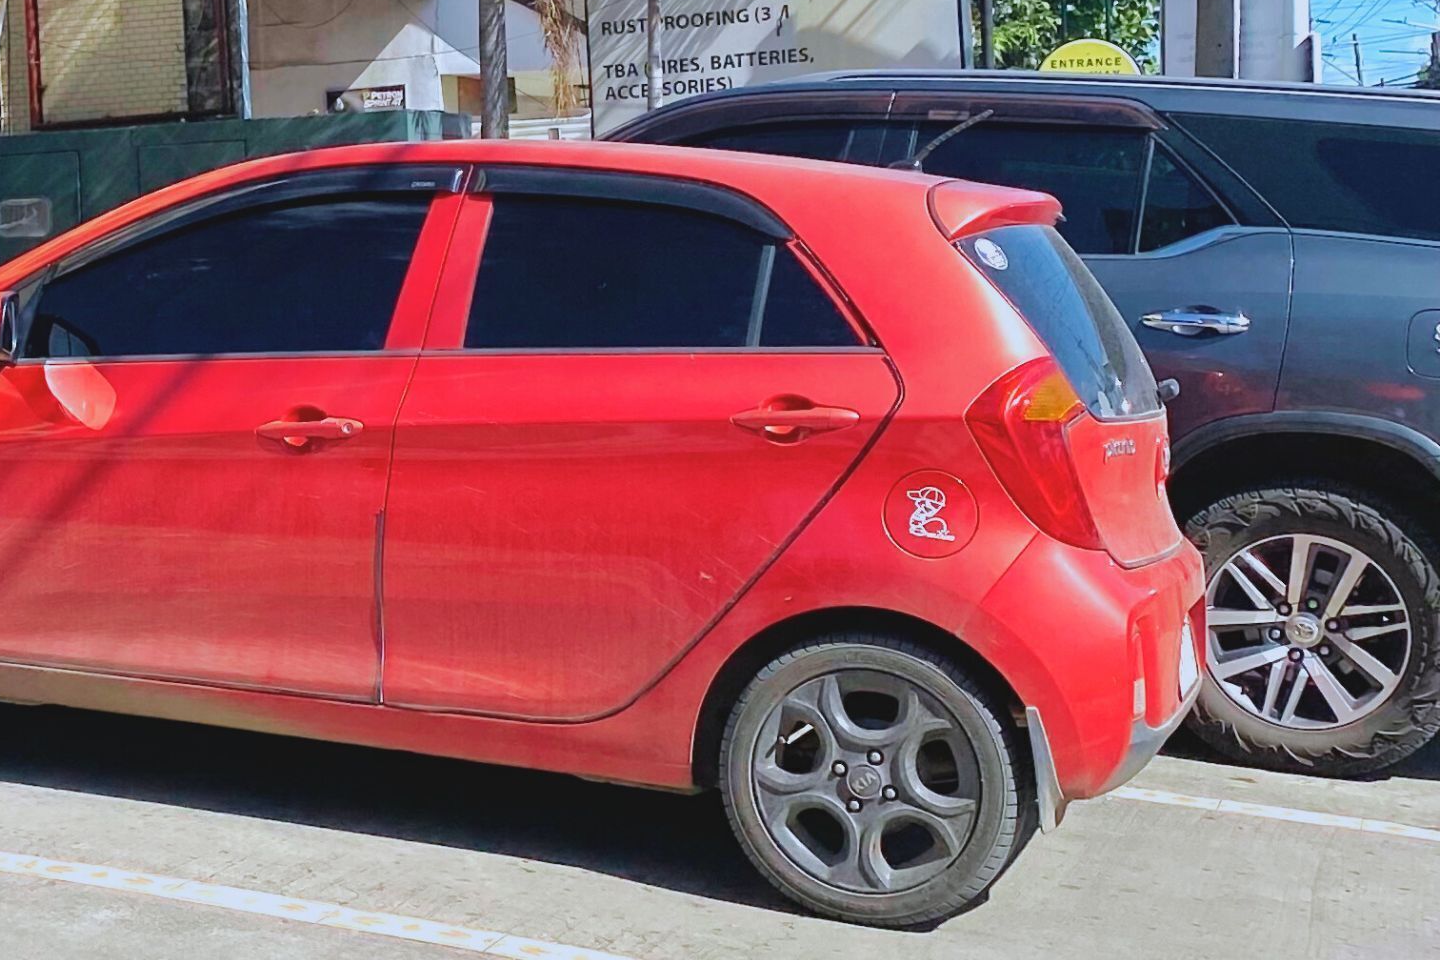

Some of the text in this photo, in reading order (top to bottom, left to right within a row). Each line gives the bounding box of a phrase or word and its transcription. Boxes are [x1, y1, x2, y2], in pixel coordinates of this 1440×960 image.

[603, 47, 815, 79] TBA (IRES, BATTERIES,
[1050, 56, 1122, 69] ENTRANCE
[604, 75, 733, 101] ACCESORIES)
[851, 771, 878, 793] KIA
